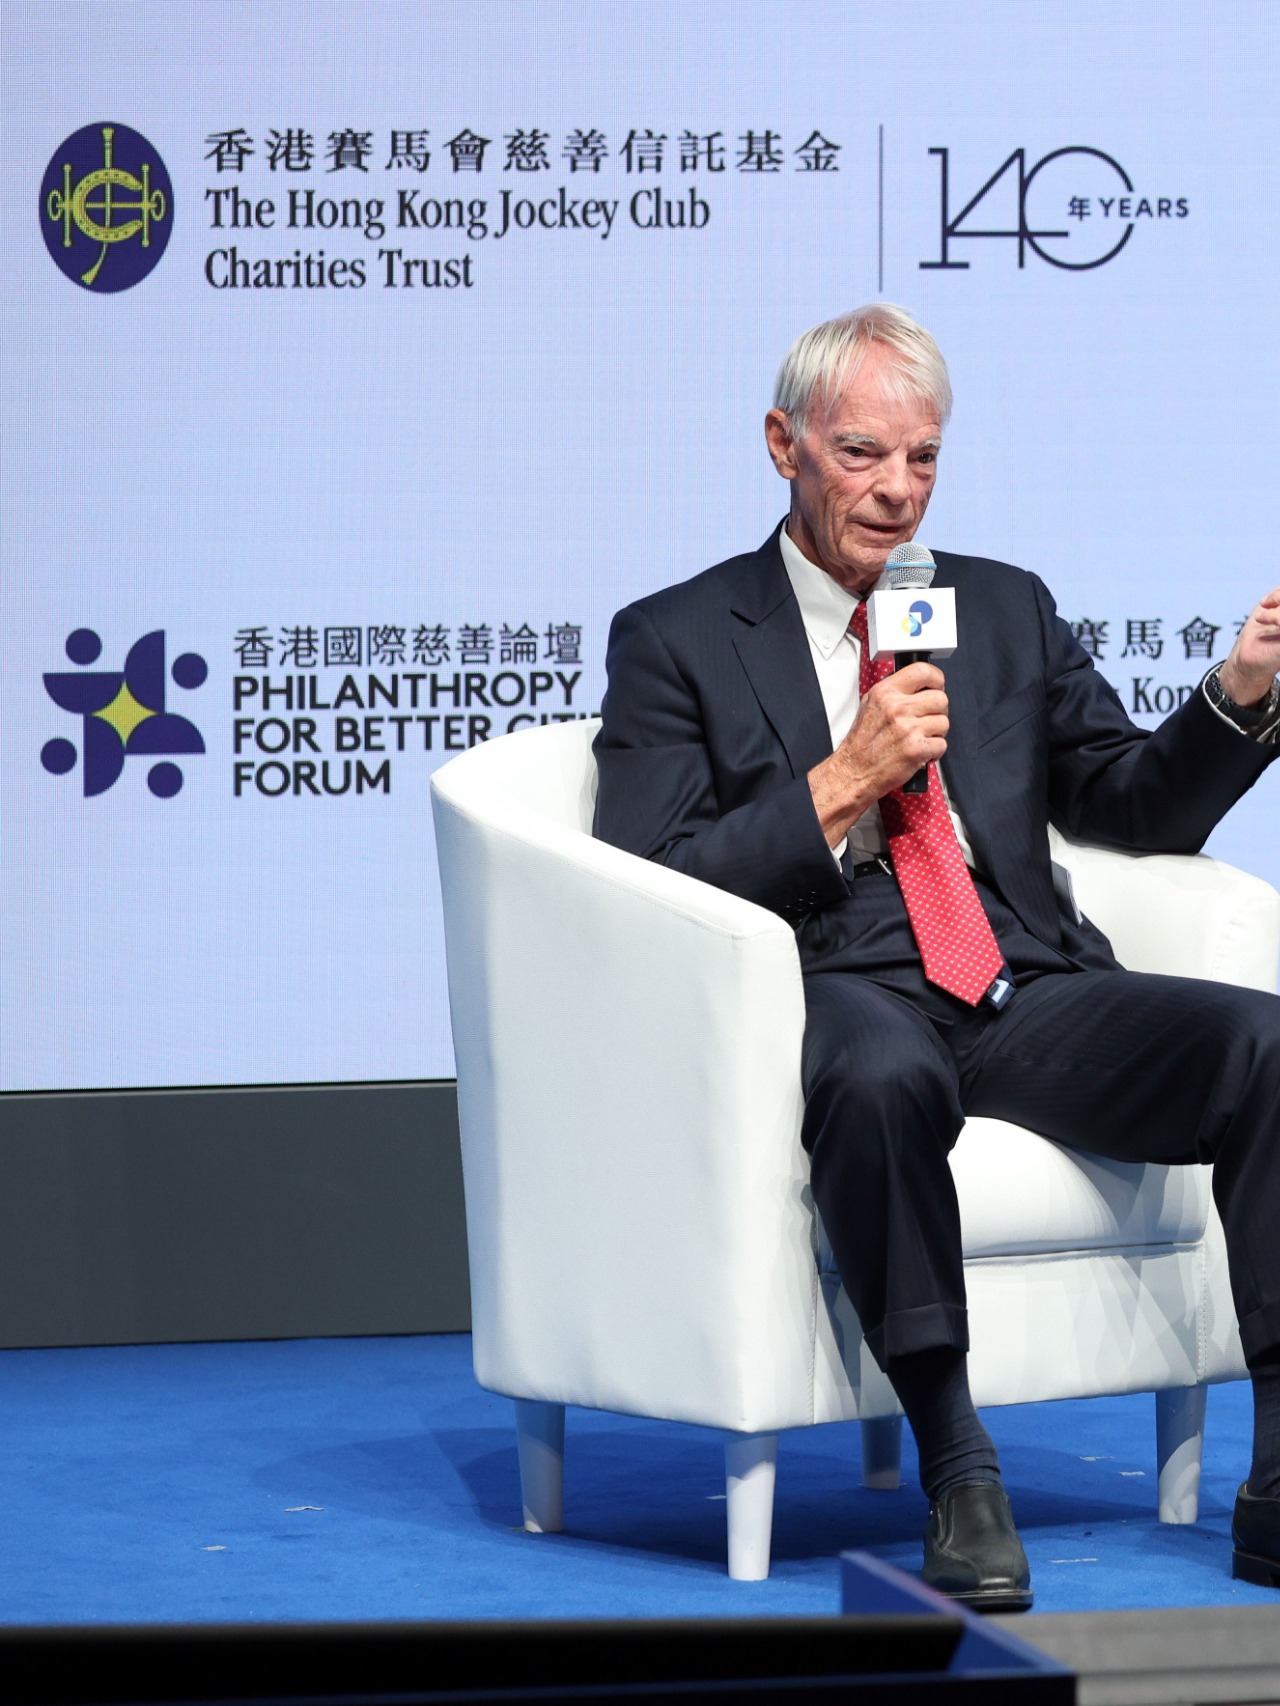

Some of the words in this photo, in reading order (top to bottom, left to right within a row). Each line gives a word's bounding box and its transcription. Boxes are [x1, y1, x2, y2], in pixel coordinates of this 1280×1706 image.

[204, 127, 841, 174] 香港賽馬會慈善信託基金
[204, 189, 275, 230] The
[287, 189, 386, 241] Hong
[397, 189, 489, 240] Kong
[493, 187, 620, 240] Jockey
[629, 187, 711, 230] Club
[918, 145, 1135, 271] 140
[1098, 197, 1190, 219] YEARS
[204, 248, 367, 289] Charities
[378, 248, 474, 289] Trust
[234, 621, 584, 669] 香港國際慈善論壇
[233, 671, 583, 712] PHILANTHROPY
[233, 717, 322, 755] FOR
[334, 714, 492, 753] BETTER
[233, 759, 392, 798] FORUM
